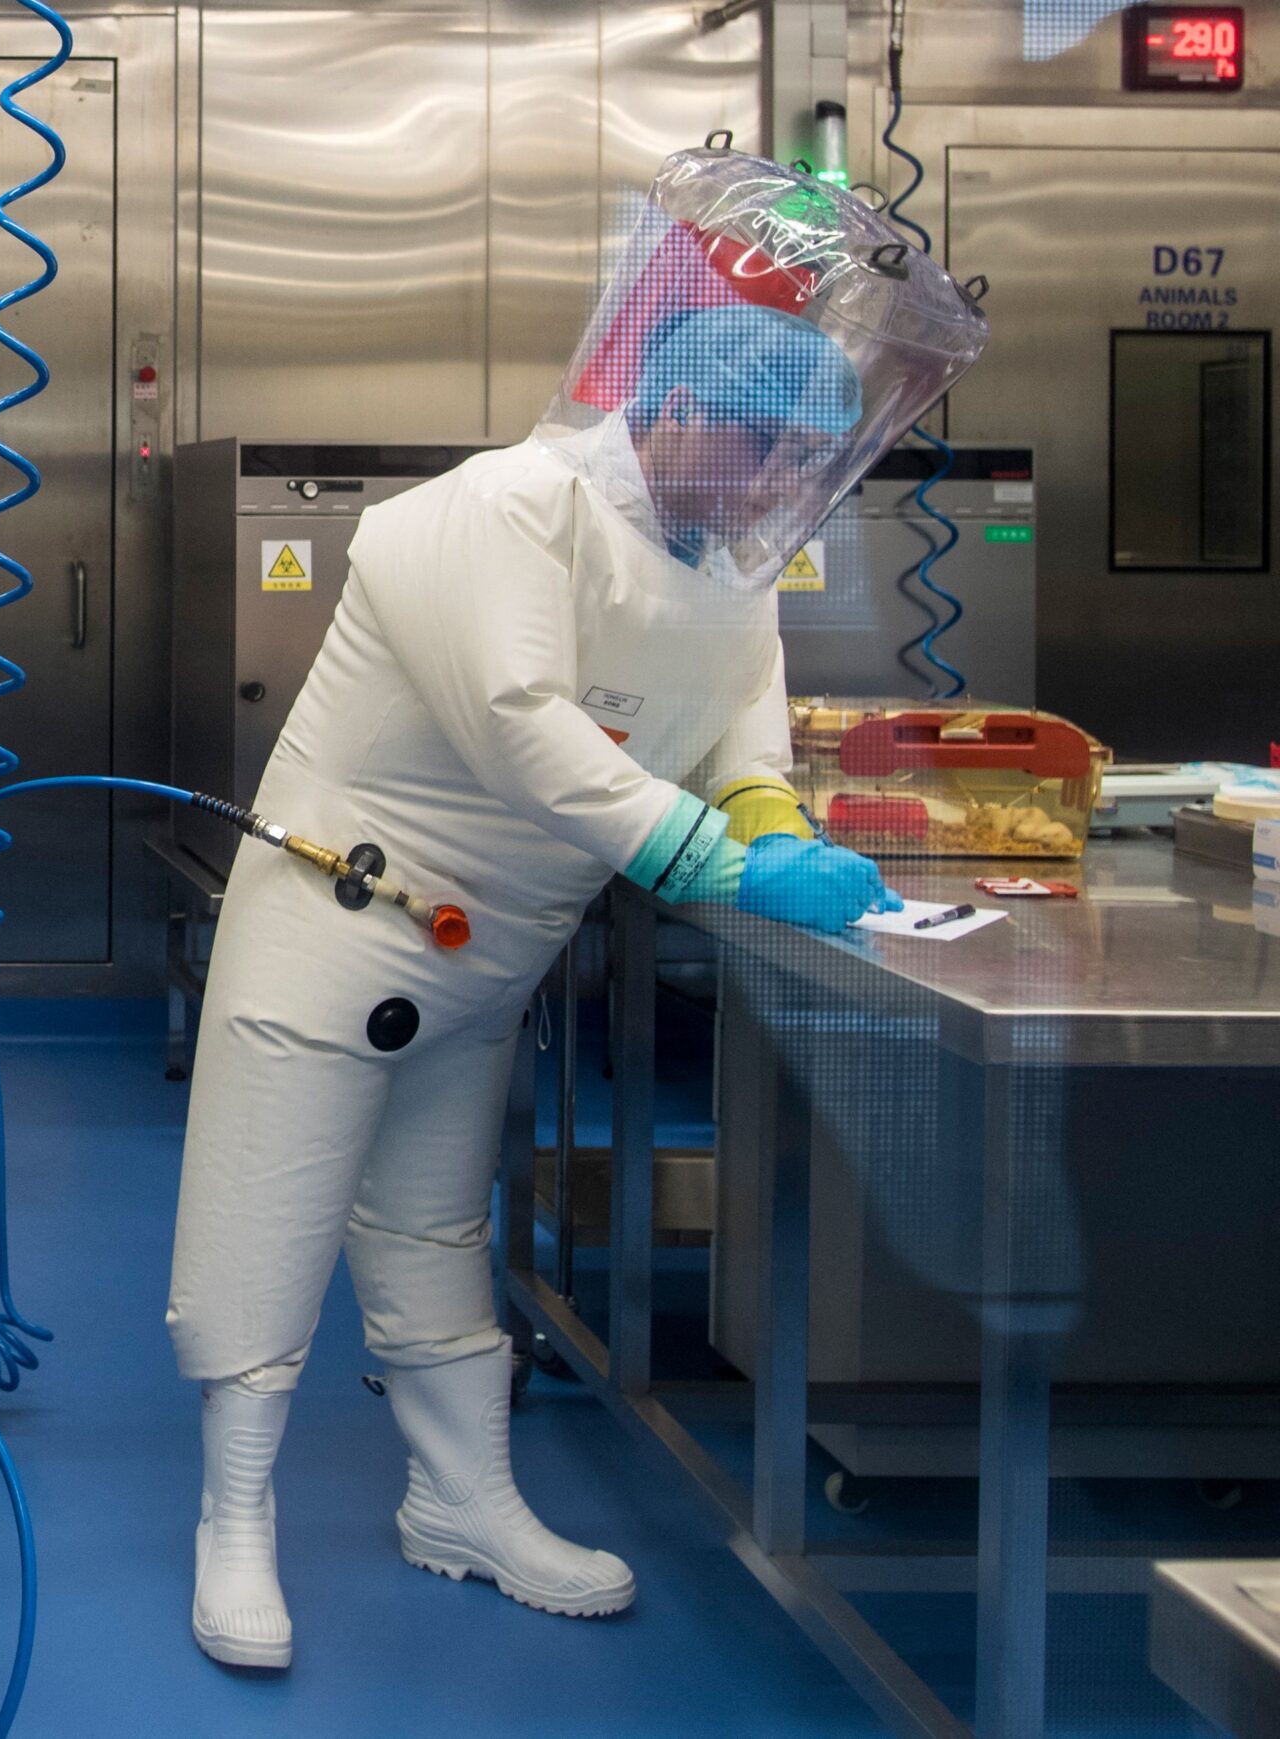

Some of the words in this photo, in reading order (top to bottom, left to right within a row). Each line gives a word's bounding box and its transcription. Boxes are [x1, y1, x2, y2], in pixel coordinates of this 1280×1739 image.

[1153, 246, 1224, 277] D67
[1139, 286, 1238, 306] ANIMALS
[1146, 311, 1212, 330] ROOM
[1216, 311, 1230, 330] 2
